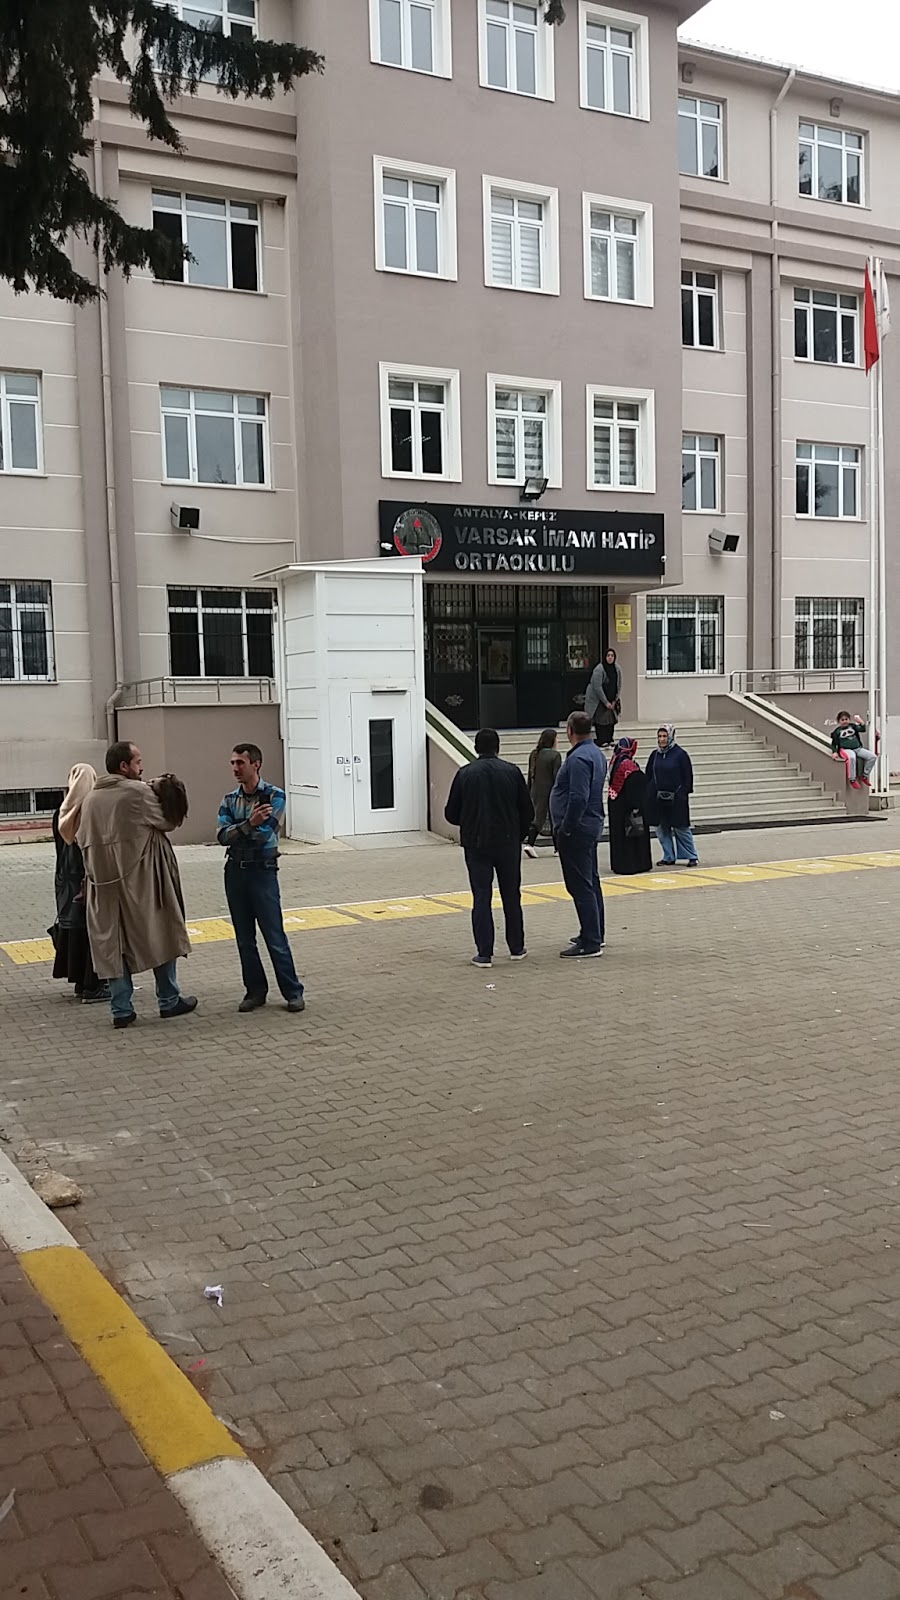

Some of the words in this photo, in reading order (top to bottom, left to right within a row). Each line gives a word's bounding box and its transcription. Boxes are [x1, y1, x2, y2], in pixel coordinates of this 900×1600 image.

[453, 508, 557, 522] ANTALYA-KEPEZ
[453, 526, 537, 547] VARSAK
[542, 526, 596, 548] İMAM
[601, 529, 656, 550] HATİP
[454, 552, 575, 572] ORTAOKULU
